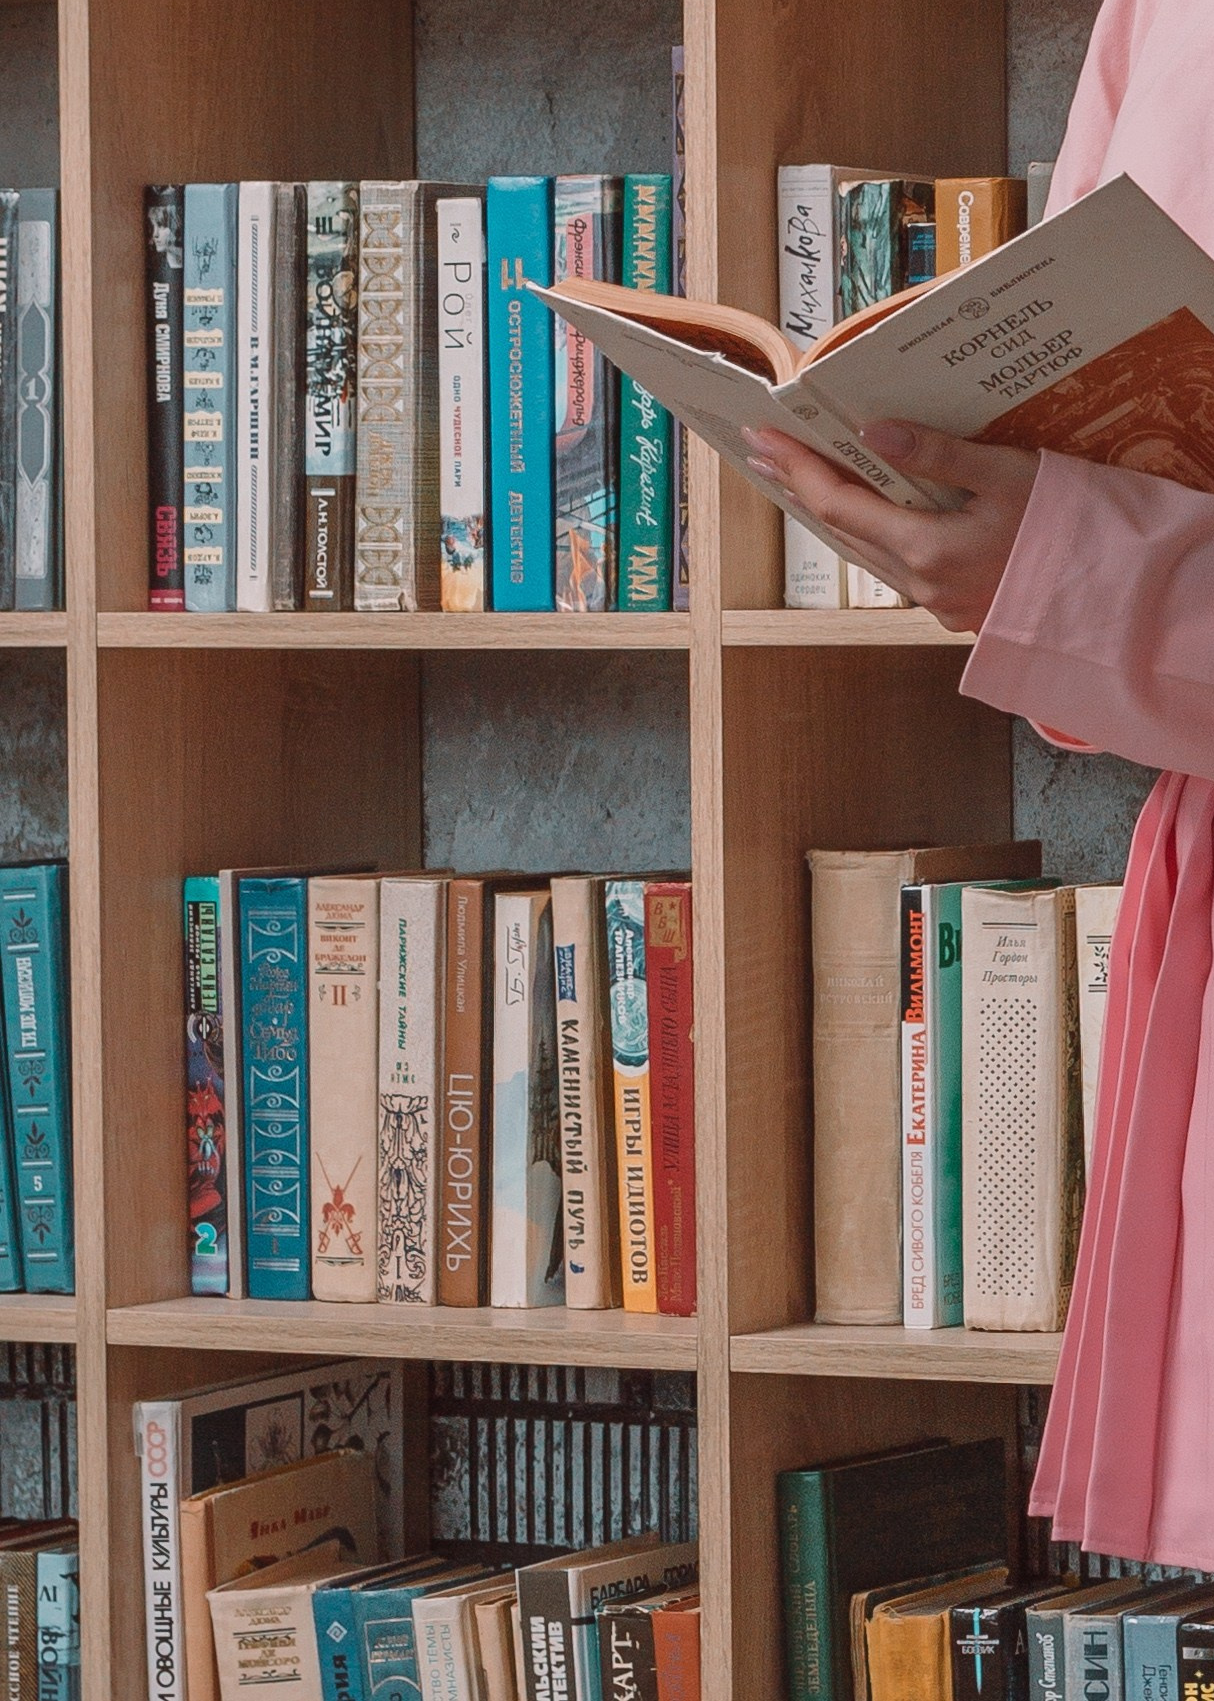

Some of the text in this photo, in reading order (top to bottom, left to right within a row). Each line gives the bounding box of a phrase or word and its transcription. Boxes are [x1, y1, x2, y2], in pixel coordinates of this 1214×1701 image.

[152, 281, 172, 402] Дуня СМИРНОВА
[897, 317, 955, 354] ШКОЛЬНАЯ
[940, 295, 1054, 368] КОРНЕЛЬ
[977, 327, 1075, 393] МОЛЬЕР
[988, 330, 1037, 361] СИД
[999, 344, 1083, 399] ТАРТЮФ
[452, 374, 462, 488] ОДНО ЧУДЕСНОЕ ПАРИ
[508, 299, 526, 584] ОСТРОСЮЖЕТНЫЙ ДЕТЕКТИВ
[832, 438, 895, 488] МОЛЬЕР
[157, 506, 177, 576] СВЯЗЬ
[200, 905, 217, 1009] ТЕНЬ САТАНЫ
[455, 894, 468, 955] Людмила
[16, 958, 35, 1012] МОПАССАН
[396, 916, 409, 1050] ПАРИЖСКИЕ ТАЙНЫ
[982, 970, 1038, 987] Просторы
[904, 910, 928, 1146] ЕКАТЕРИНА ВИЛЬМОНТ
[560, 1017, 589, 1249] КАМЕНИСТЫЙ ПУТЬ
[623, 1086, 648, 1283] ИГРЫ ИДИОТОВ
[910, 1152, 926, 1311] БРЕД СИВОГО КОБЕЛЯ
[145, 1422, 175, 1689] ОВОЩНЫЕ КУЛЬТУРЫ СССР
[785, 1504, 801, 1574] СЛОВАРЬ
[6, 1584, 20, 1647] ЧТЕНИЕ
[424, 1625, 438, 1664] ТЕМЫ
[804, 1580, 821, 1694] ЗЕМЛЕДЕЛЬЦА
[1035, 1633, 1057, 1689] Степанов
